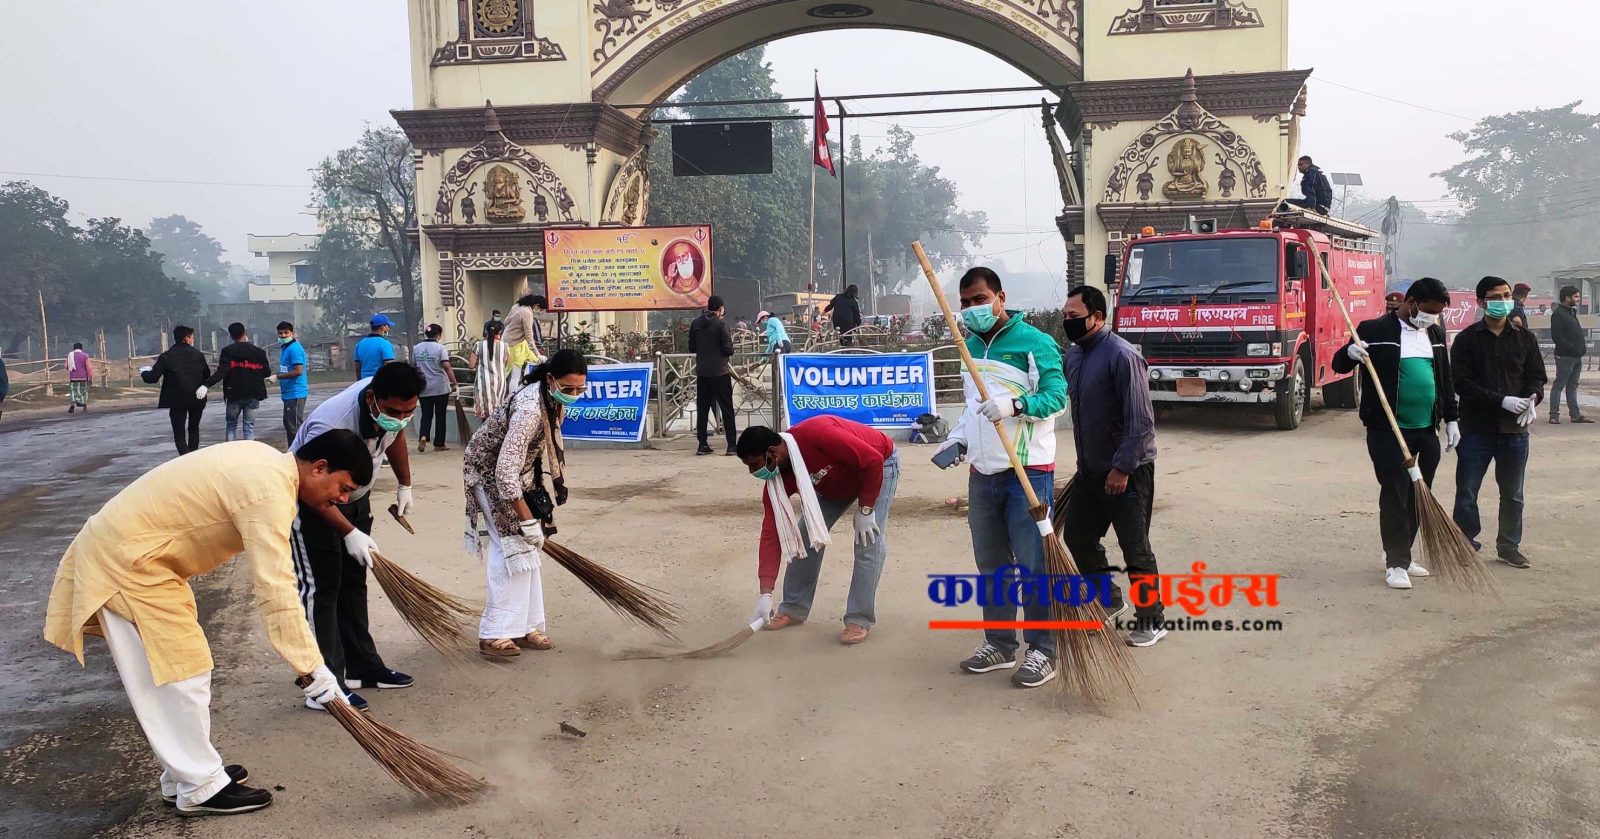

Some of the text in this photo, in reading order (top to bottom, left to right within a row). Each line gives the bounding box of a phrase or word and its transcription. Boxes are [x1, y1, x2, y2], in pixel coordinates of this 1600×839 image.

[1252, 314, 1274, 325] FIRE
[789, 366, 923, 386] VOLUNTEER
[581, 380, 642, 398] NTEER
[792, 390, 923, 411] सरसफाइ कार्यक्रम
[583, 404, 638, 420] कार्यक्रम
